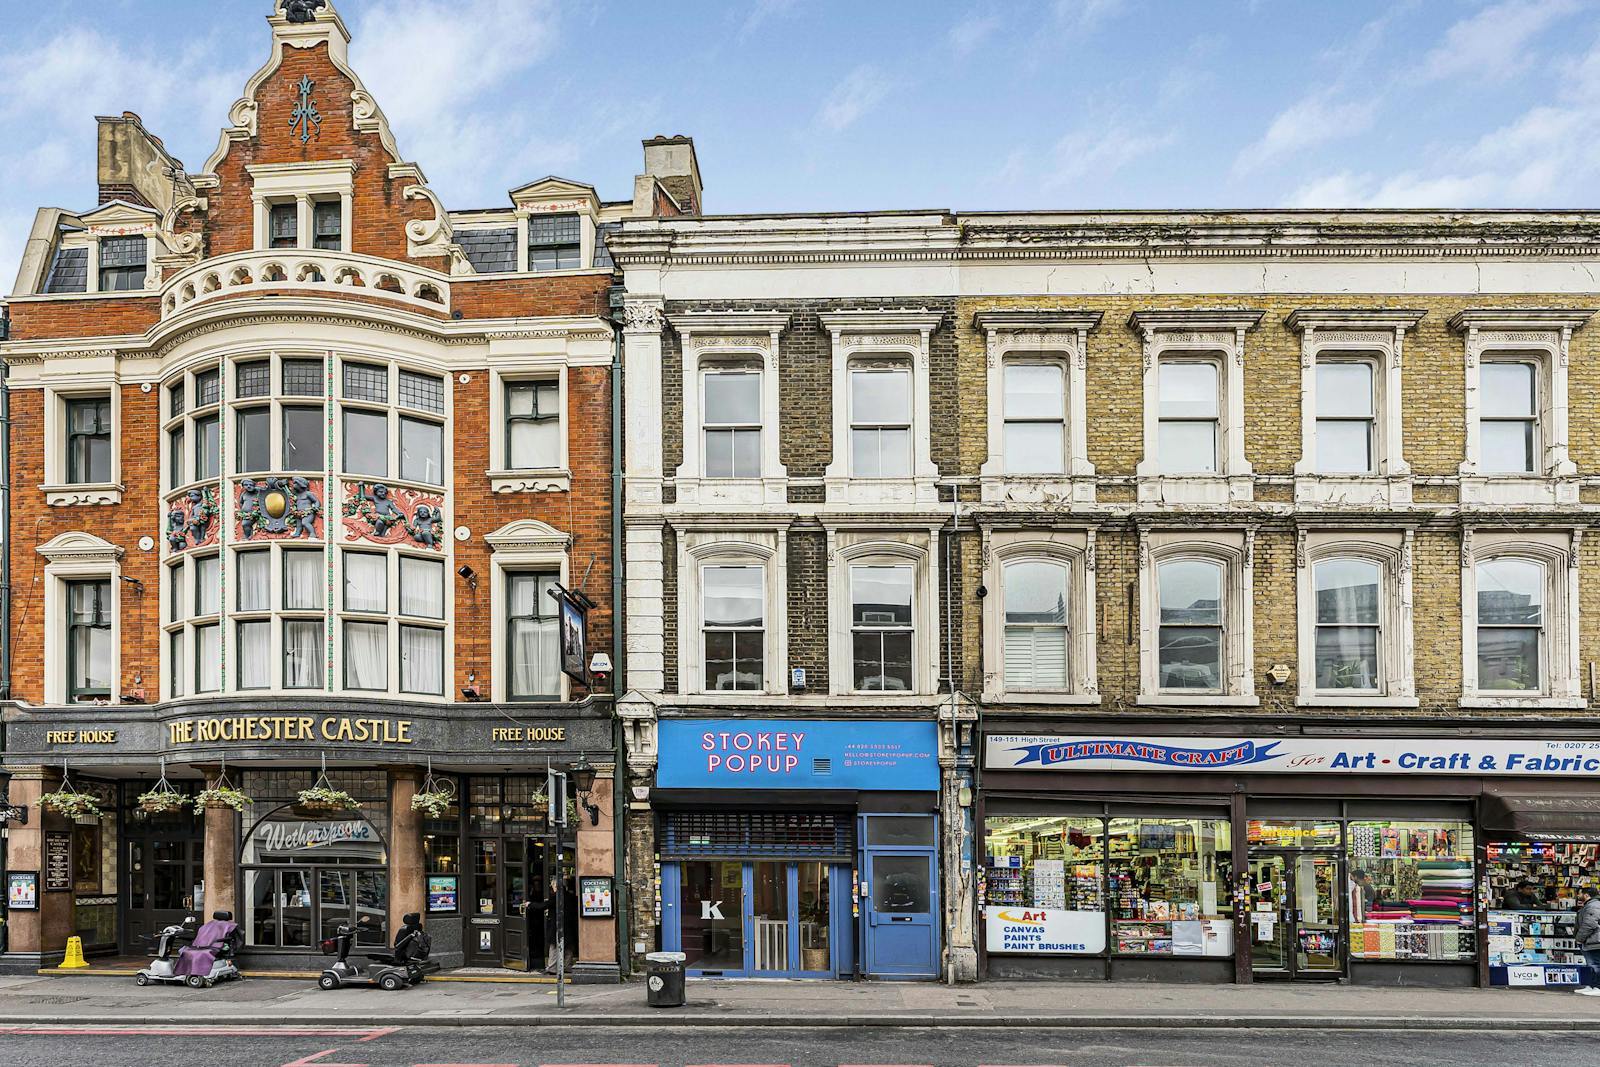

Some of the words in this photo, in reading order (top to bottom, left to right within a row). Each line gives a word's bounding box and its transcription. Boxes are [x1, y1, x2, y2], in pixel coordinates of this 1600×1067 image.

[46, 730, 77, 744] FREE
[79, 730, 117, 744] HOUSE
[168, 720, 194, 744] THE
[197, 717, 315, 742] ROCHESTER
[321, 717, 413, 743] CASTLE
[492, 727, 524, 741] FREE
[527, 727, 566, 741] HOUSE
[701, 732, 806, 751] STOKEY
[708, 754, 799, 773] POPUP
[1047, 743, 1167, 762] ULTIMATE
[1170, 744, 1249, 765] CRAFT
[1330, 752, 1376, 769] Art
[1398, 752, 1471, 769] Craft
[1478, 755, 1497, 770] &
[1505, 753, 1600, 771] Fabric
[260, 820, 364, 852] Wetherspoon
[700, 900, 725, 920] K
[1022, 911, 1047, 921] Art
[1038, 943, 1086, 951] BRUSHES
[1513, 971, 1533, 979] Lyca
